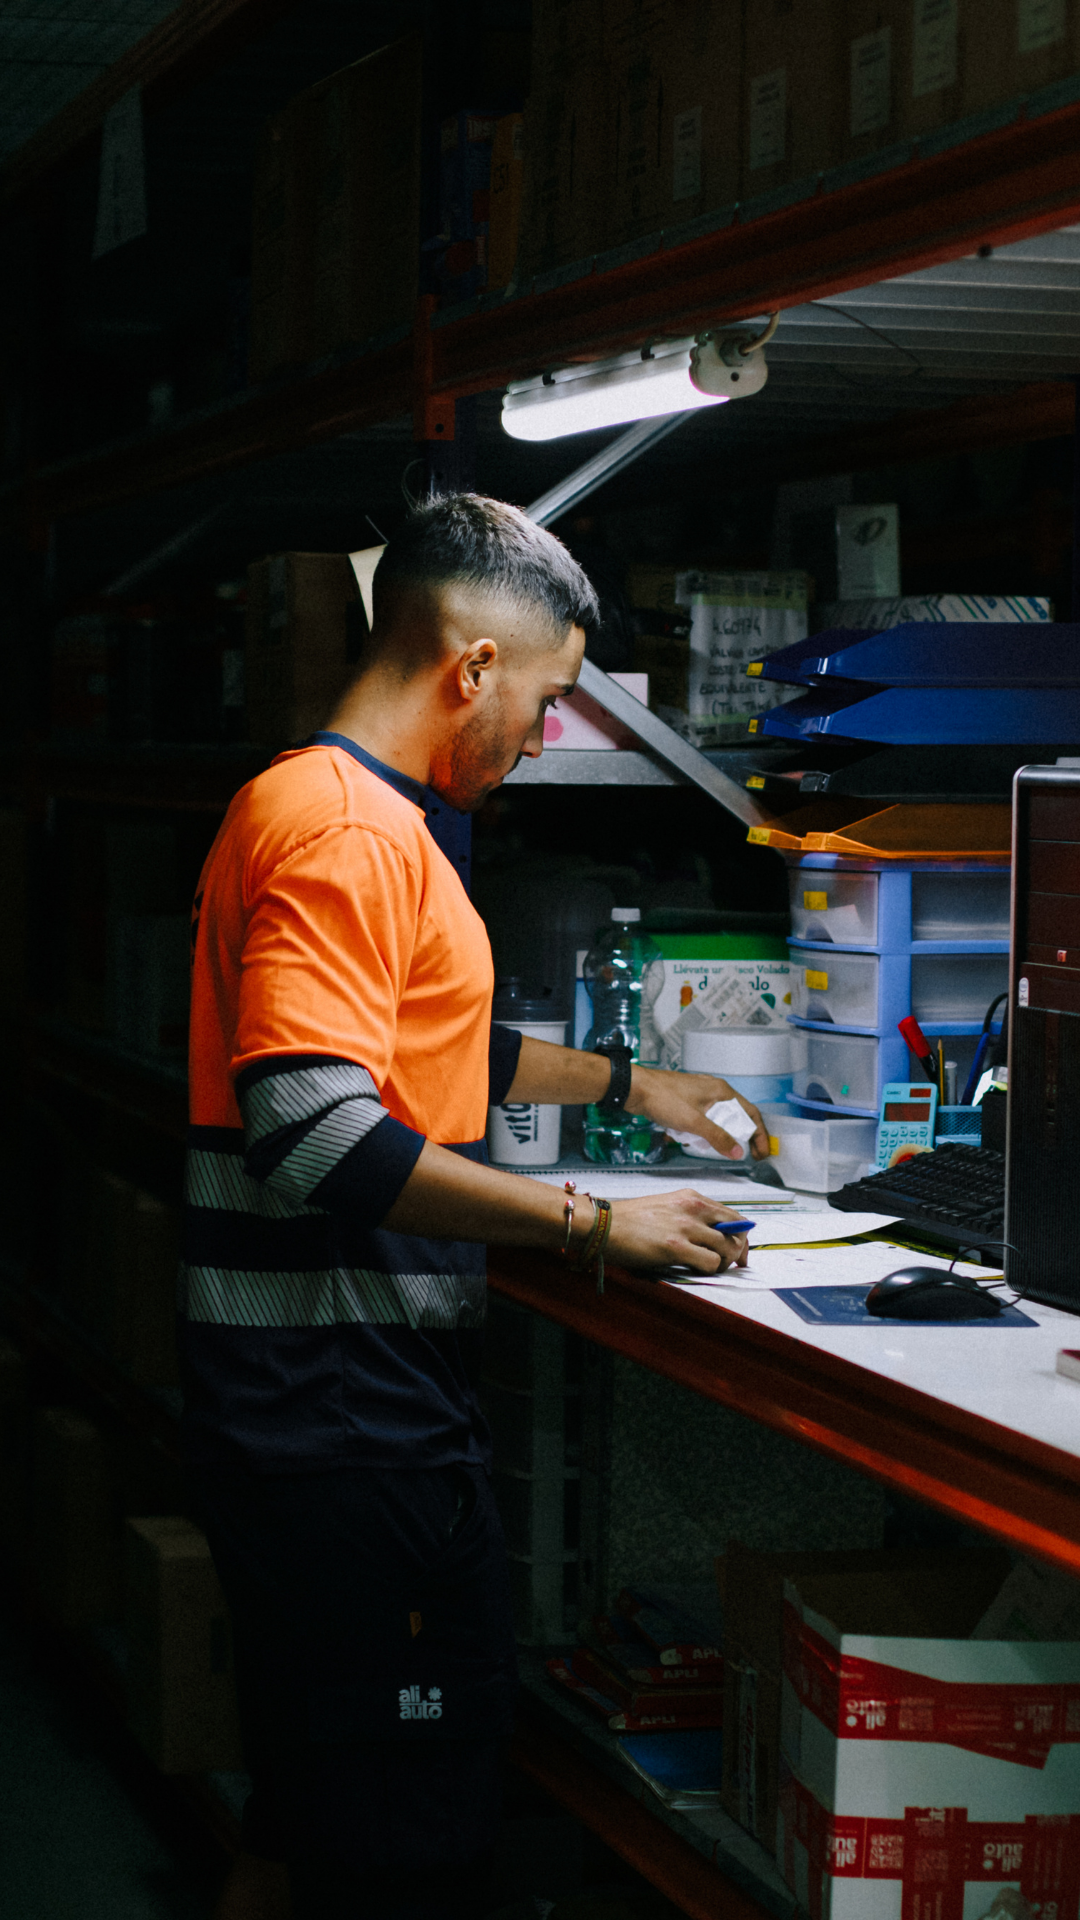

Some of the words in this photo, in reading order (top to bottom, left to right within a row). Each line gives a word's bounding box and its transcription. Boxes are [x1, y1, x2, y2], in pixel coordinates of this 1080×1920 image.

[662, 1668, 699, 1680] APLI
[398, 1685, 421, 1703] ali
[398, 1700, 443, 1720] auto
[640, 1715, 676, 1726] APLI
